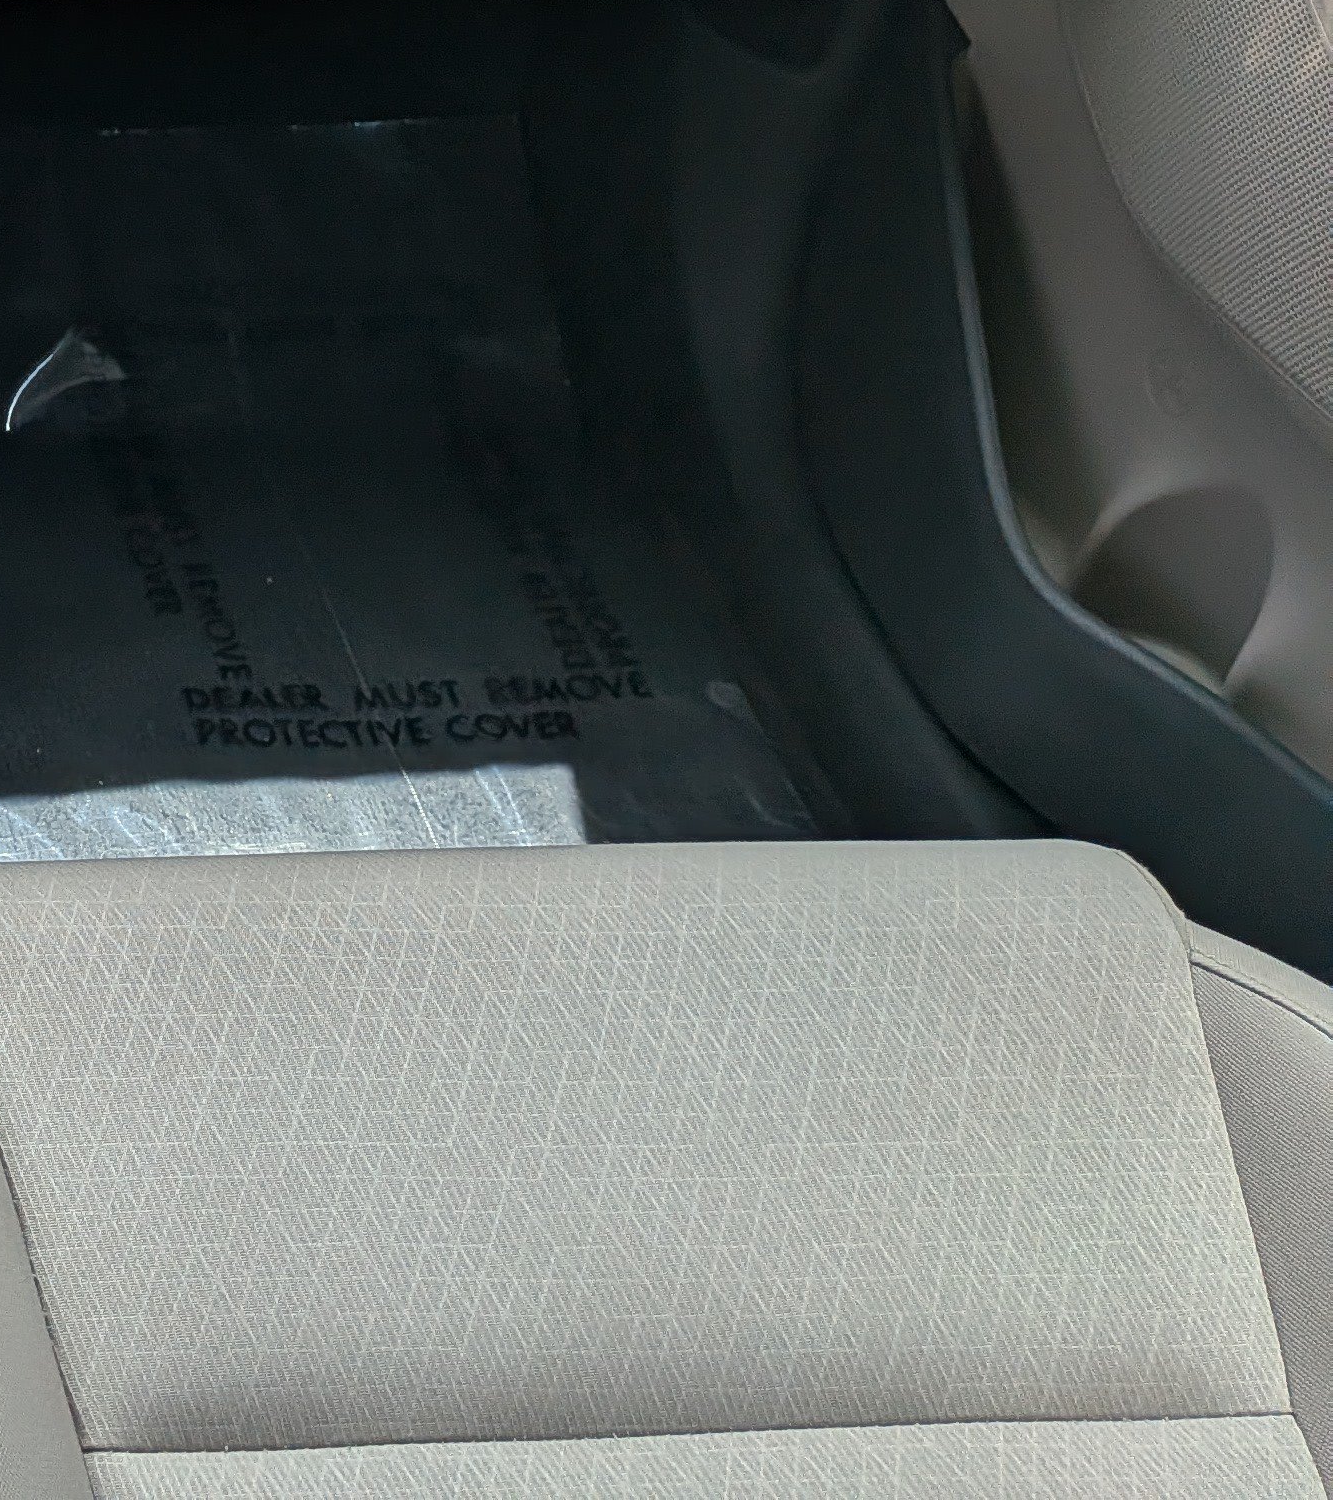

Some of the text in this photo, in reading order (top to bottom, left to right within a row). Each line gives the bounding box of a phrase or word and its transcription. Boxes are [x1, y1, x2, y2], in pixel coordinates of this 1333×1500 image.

[181, 670, 653, 713] DEALER MUST REMOVE
[197, 709, 580, 747] PROTECTIVE COVER
